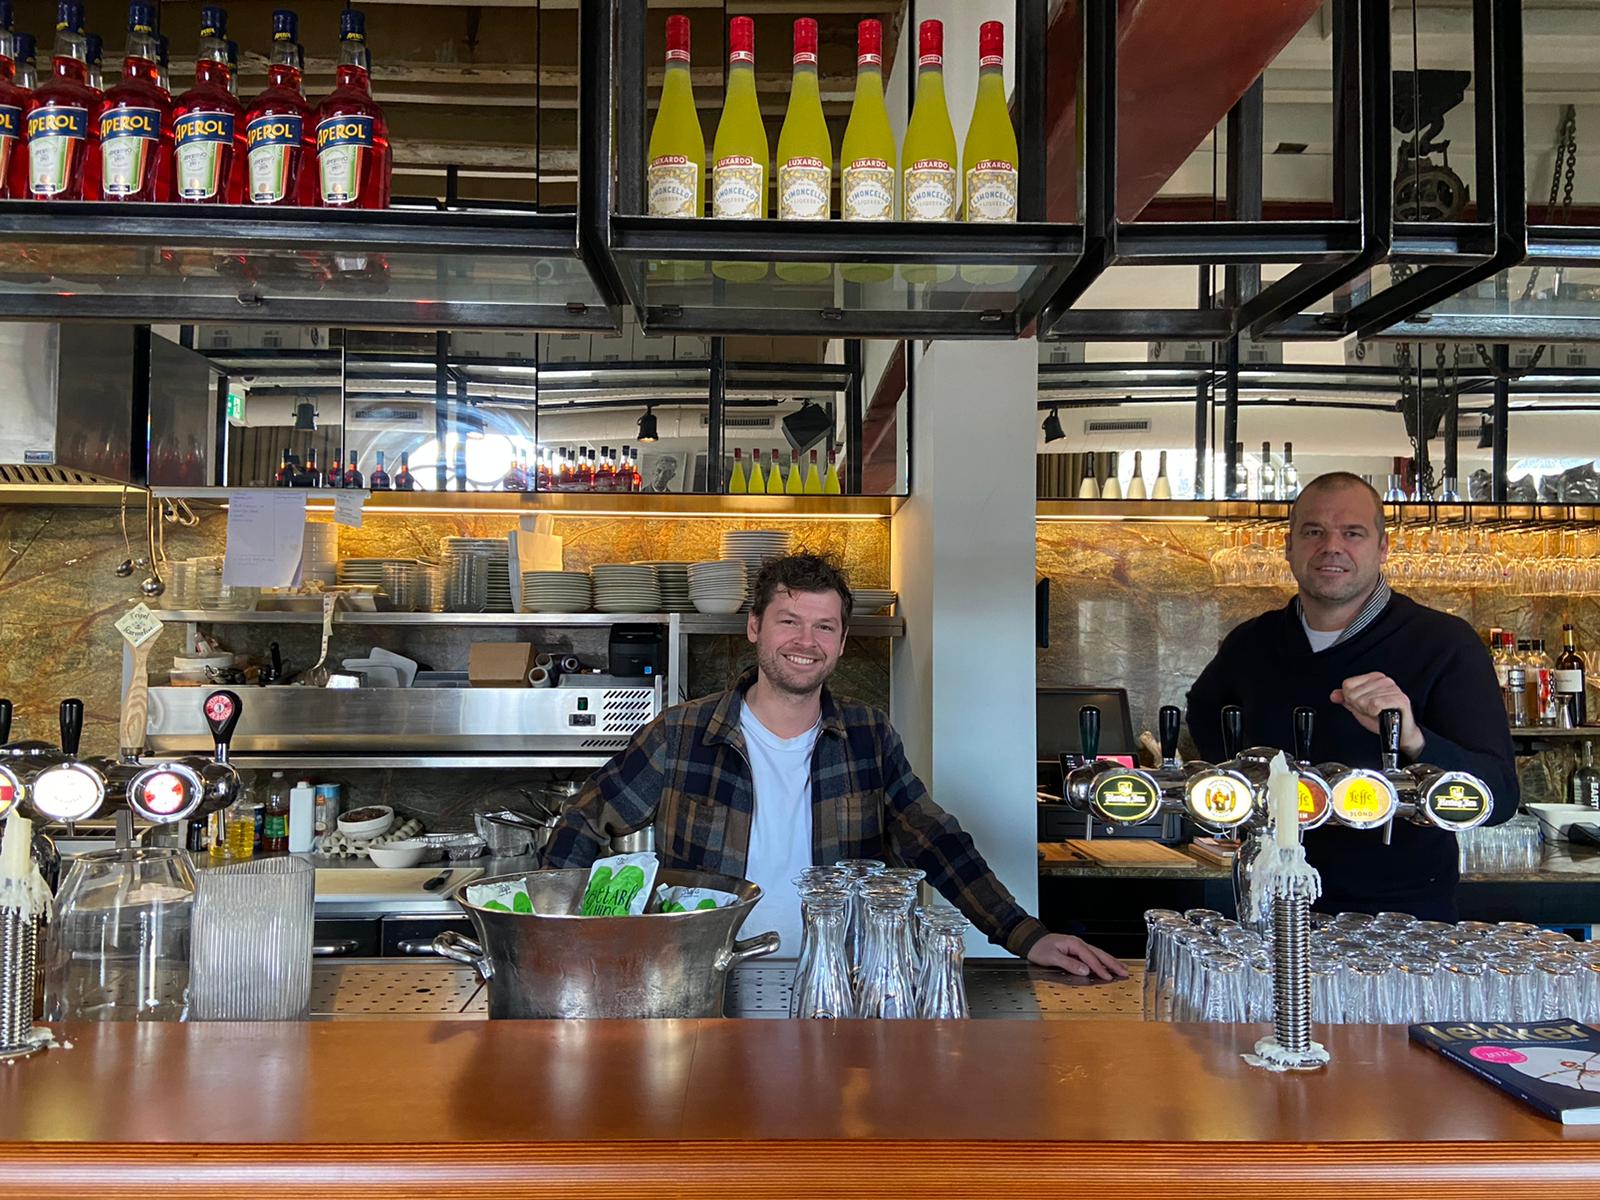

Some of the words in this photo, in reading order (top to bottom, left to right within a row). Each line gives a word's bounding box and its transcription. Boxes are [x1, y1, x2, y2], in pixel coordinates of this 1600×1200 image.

[28, 114, 78, 137] APEROL
[100, 115, 152, 139] APEROL
[175, 120, 225, 145] APEROL
[246, 123, 293, 148] APEROL
[317, 122, 366, 149] APEROL
[652, 156, 685, 166] LUXARDO
[718, 156, 752, 167] LUXARDO
[788, 158, 822, 168] LUXARDO
[852, 160, 887, 169] LUXARDO
[914, 161, 949, 170] LUXARDO
[977, 161, 1011, 171] LUXARDO
[715, 185, 755, 201] LIMONCELLO
[784, 186, 826, 203] LIMONCELLO
[848, 190, 890, 205] LIMONCELLO
[909, 190, 952, 205] LIMONCELLO
[973, 191, 1014, 206] LIMONCELLO
[1349, 789, 1372, 806] Leffe
[1590, 782, 1599, 810] EART
[1420, 1023, 1590, 1041] lekker
